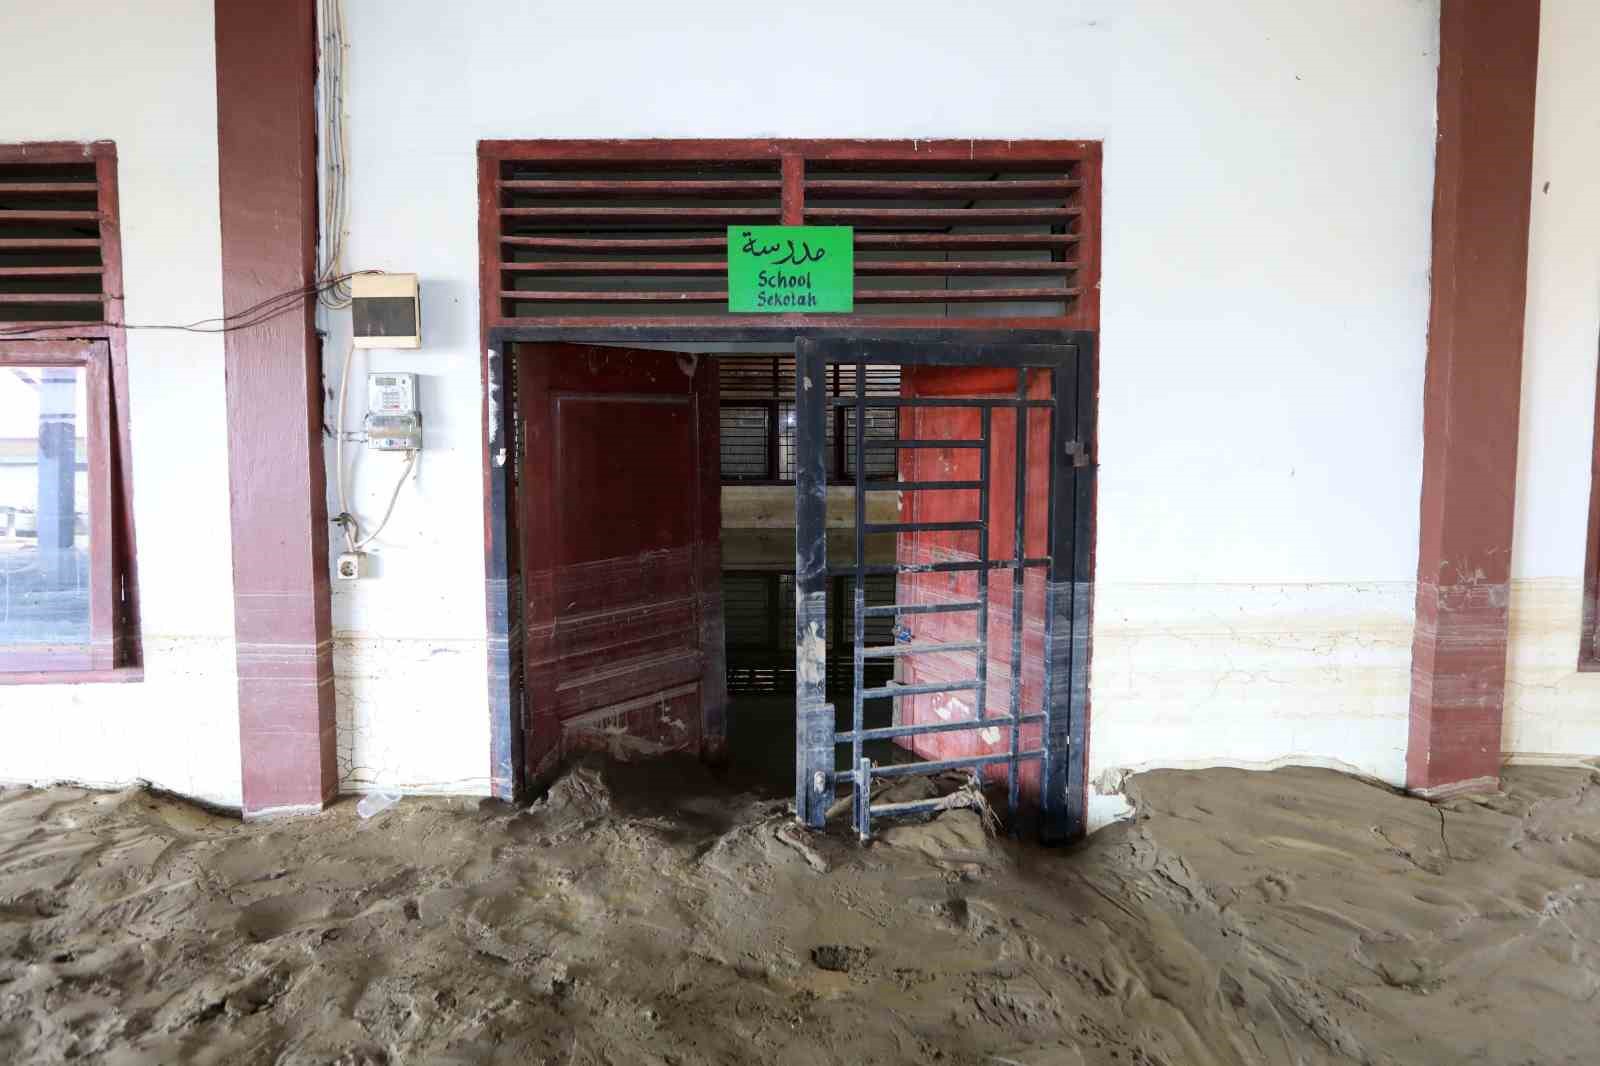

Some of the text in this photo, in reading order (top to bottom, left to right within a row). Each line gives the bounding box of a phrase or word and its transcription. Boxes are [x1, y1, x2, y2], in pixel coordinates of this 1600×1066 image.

[742, 232, 826, 265] مدرسة
[758, 270, 811, 288] School
[757, 291, 817, 307] Sekolah
